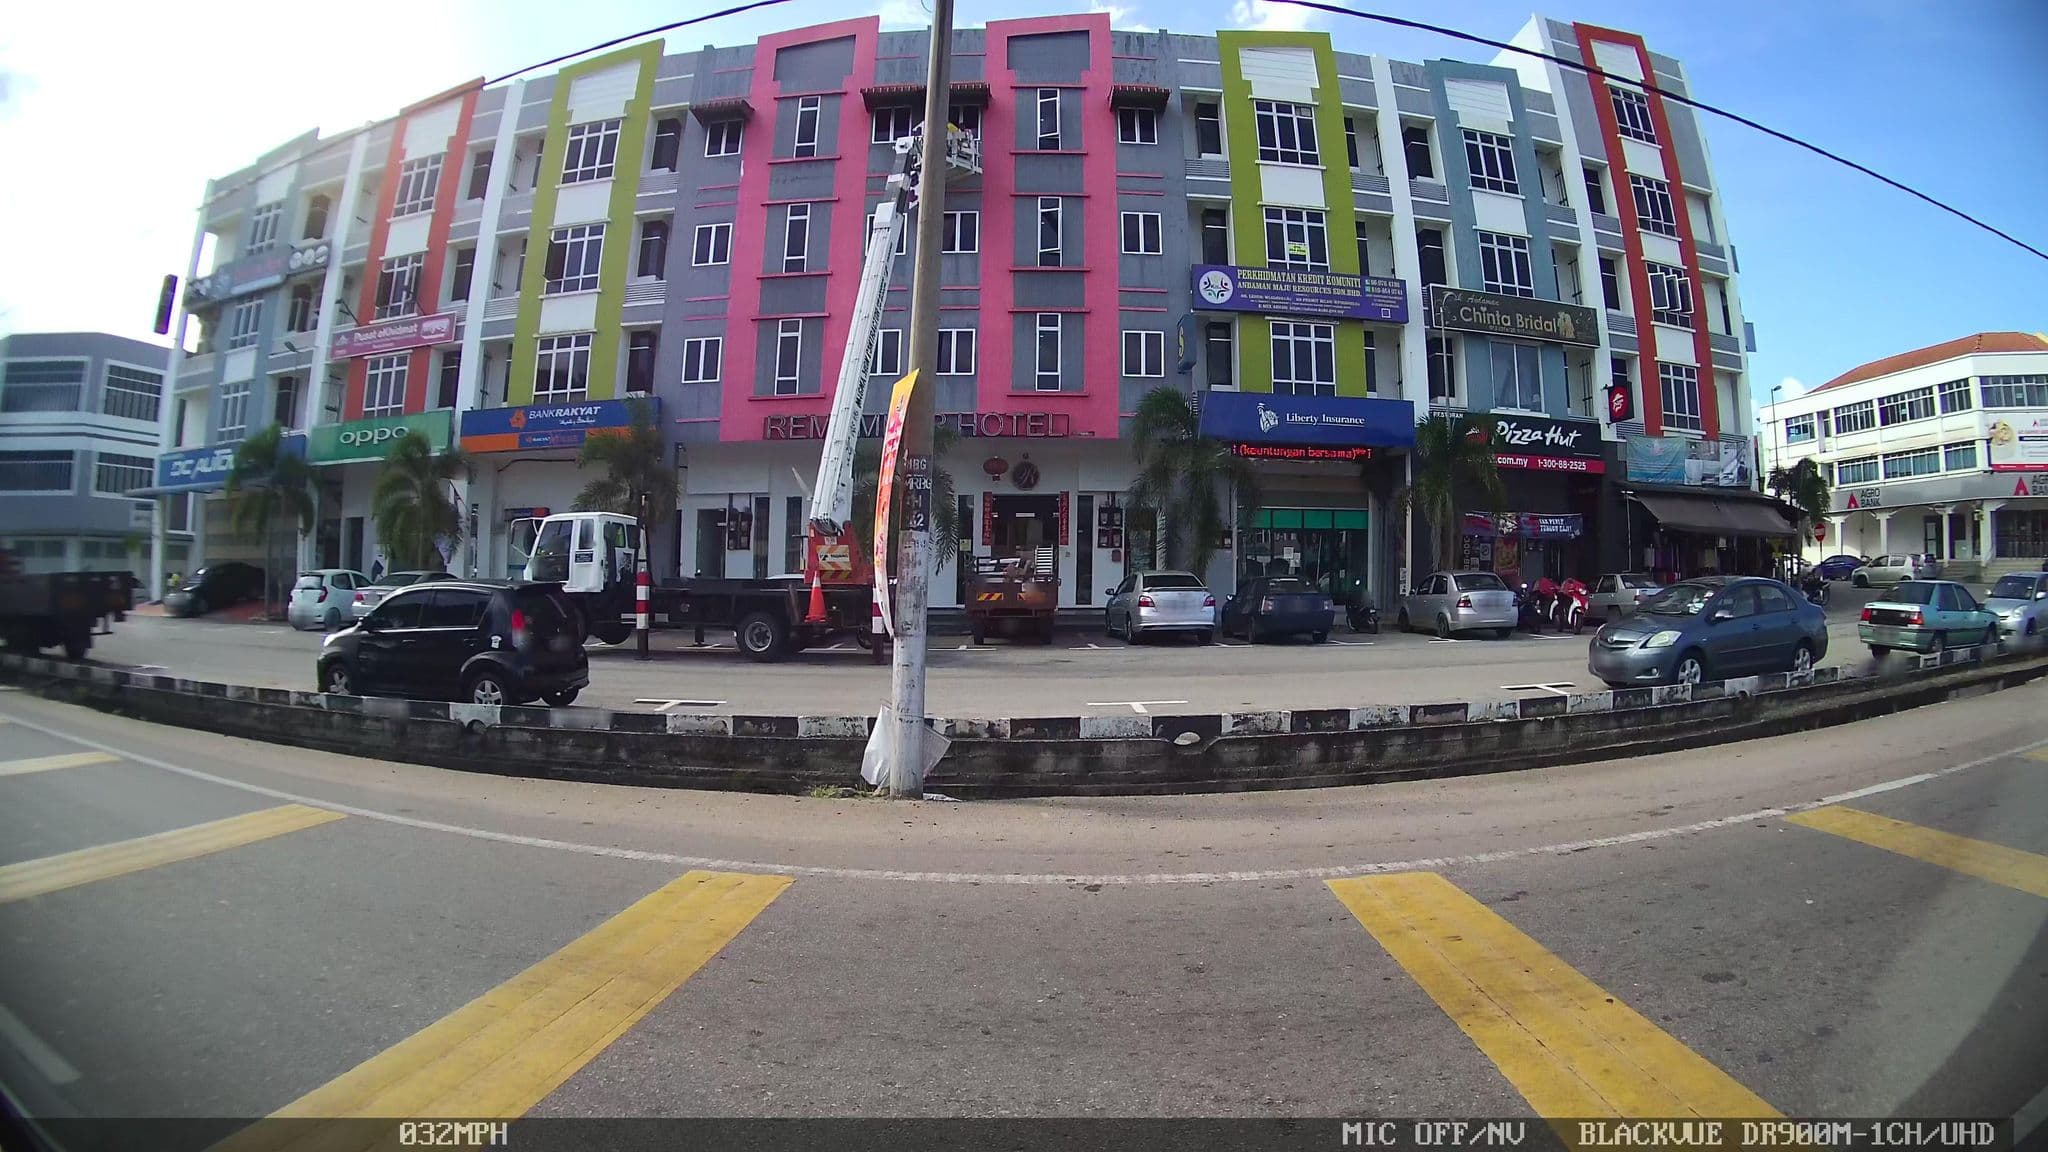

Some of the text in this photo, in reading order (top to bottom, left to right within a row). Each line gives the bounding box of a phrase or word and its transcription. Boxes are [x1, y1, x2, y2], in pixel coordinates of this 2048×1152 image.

[1237, 269, 1361, 288] PERKHIDMATAN KREDIT KOMUNITI
[1237, 281, 1272, 290] ANDAMAN
[1273, 283, 1291, 291] MAJU
[1293, 285, 1331, 294] RESOURCES
[1459, 306, 1511, 327] Chinta
[1516, 313, 1557, 333] Bridal
[957, 411, 1064, 437] HOTEL
[1286, 412, 1365, 426] Liberty Insurance
[339, 426, 409, 446] oppo
[1491, 421, 1543, 445] Pizza
[1538, 459, 1587, 471] 1-300-88-2525
[1861, 488, 1880, 498] AGRO
[1861, 498, 1881, 508] BANK
